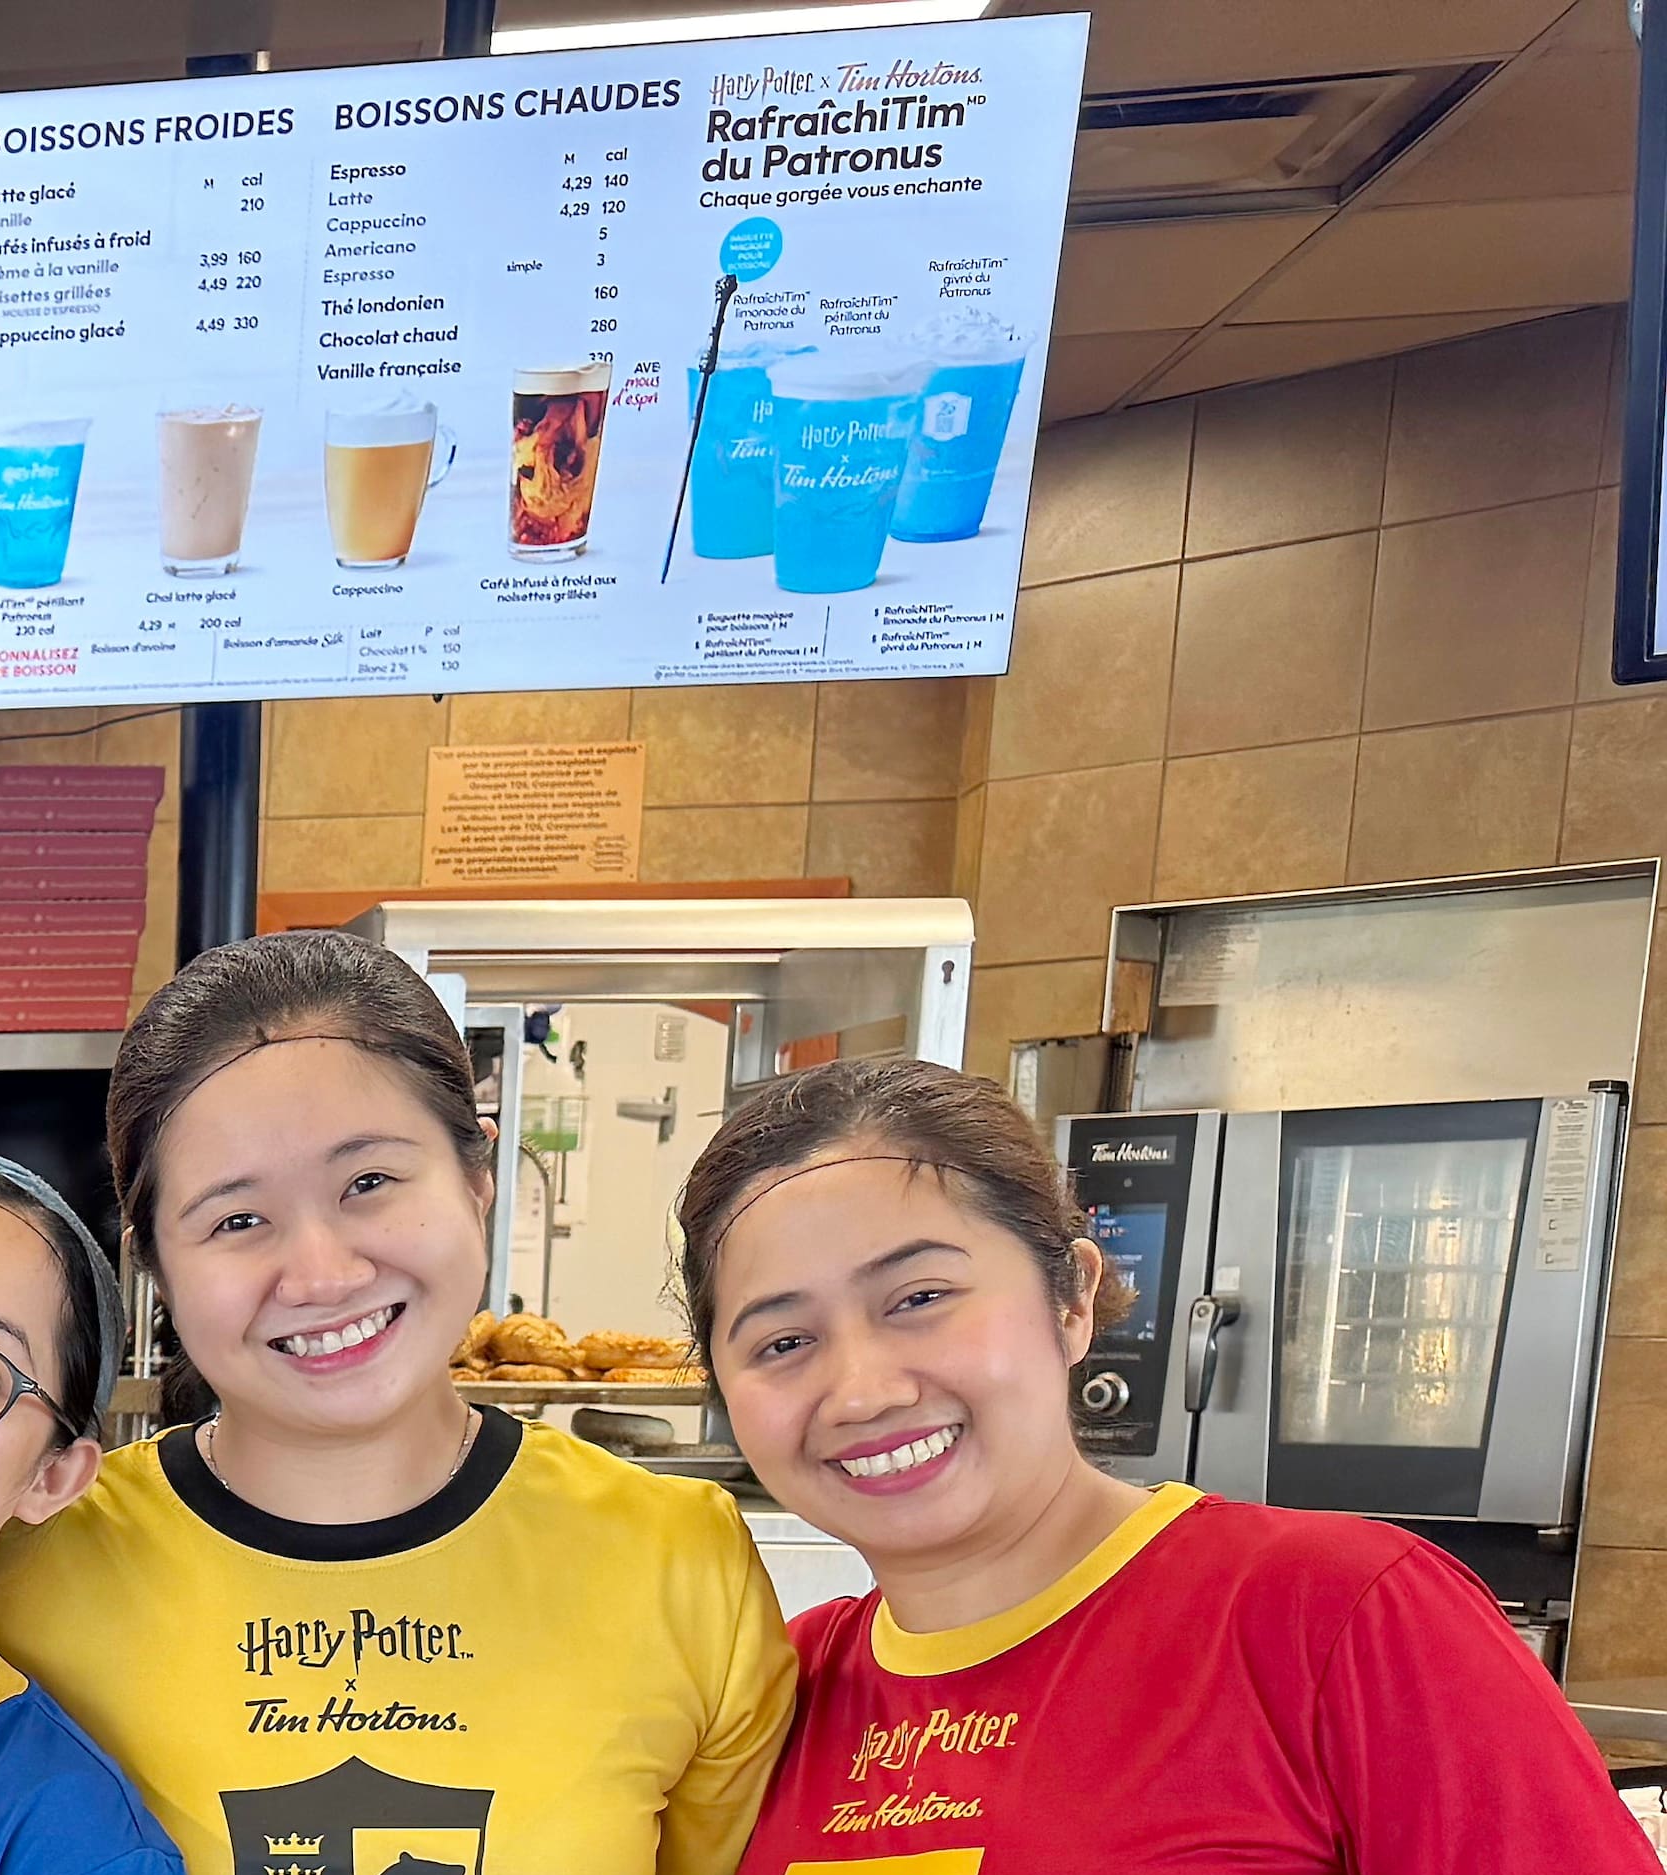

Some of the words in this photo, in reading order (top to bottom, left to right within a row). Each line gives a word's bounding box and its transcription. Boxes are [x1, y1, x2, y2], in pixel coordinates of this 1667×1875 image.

[710, 73, 760, 106] Harry
[762, 67, 814, 100] Potter
[838, 63, 879, 93] Tim
[335, 92, 505, 129] BOISSONS
[514, 80, 681, 117] CHAUDES
[155, 108, 294, 143] FROIDES
[605, 148, 627, 162] cal
[702, 148, 751, 182] du
[763, 143, 942, 178] Patronus
[242, 173, 263, 187] cal
[330, 164, 406, 183] Espresso
[604, 174, 629, 187] 140
[29, 182, 76, 205] glacé
[329, 192, 373, 206] Latte
[699, 191, 771, 210] Chaque
[776, 184, 842, 207] gorgée
[847, 186, 889, 198] vous
[894, 177, 982, 195] enchante
[240, 199, 264, 212] 210
[602, 201, 626, 214] 120
[326, 214, 426, 234] Cappuccino
[31, 234, 90, 253] infusés
[94, 234, 105, 249] à
[109, 231, 151, 247] froid
[599, 227, 608, 240] 5
[324, 241, 416, 258] Americano
[34, 262, 45, 277] à
[48, 262, 63, 277] la
[67, 260, 119, 276] vanille
[597, 254, 605, 266] 3
[236, 276, 261, 289] 220
[323, 268, 395, 286] Espresso
[975, 272, 990, 283] du
[54, 285, 111, 303] grillées
[940, 286, 991, 298] Patronus
[322, 299, 353, 316] Thé
[358, 295, 445, 314] londonien
[735, 305, 787, 318] limonade
[790, 305, 805, 316] du
[744, 320, 795, 330] Patronus
[825, 310, 871, 325] pétillant
[874, 309, 889, 320] du
[80, 321, 125, 342] glacé
[319, 331, 400, 348] Chocolat
[403, 326, 458, 343] chaud
[830, 324, 881, 335] Patronus
[317, 365, 375, 380] Vanille
[379, 361, 462, 379] française
[802, 425, 845, 449] Harry
[783, 464, 816, 488] Tim
[332, 584, 403, 597] Cappuccino
[481, 577, 510, 591] Café
[563, 574, 592, 588] froid
[11, 663, 76, 678] BOISSON
[237, 1617, 346, 1676] Harry
[345, 1679, 356, 1691] x
[245, 1699, 308, 1733] Tim
[847, 1720, 920, 1782] Harry
[914, 1709, 1018, 1769] Potter
[822, 1800, 872, 1833] Tim
